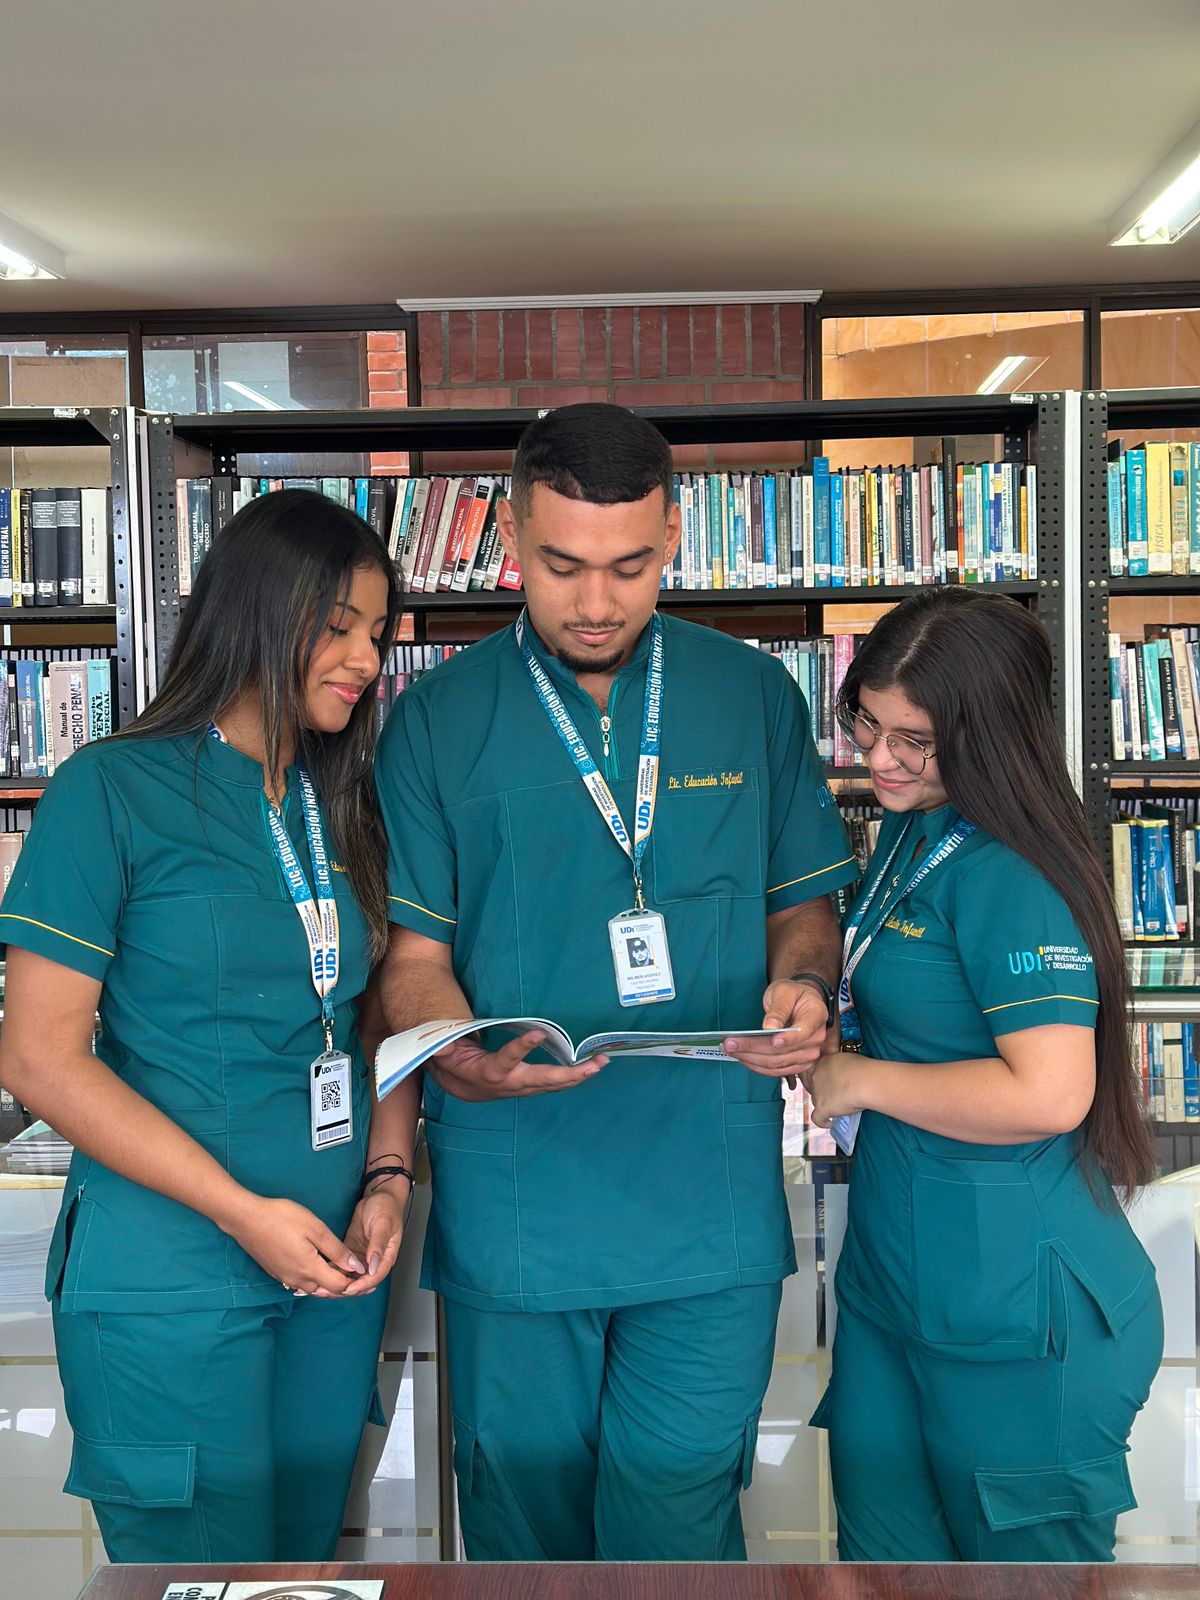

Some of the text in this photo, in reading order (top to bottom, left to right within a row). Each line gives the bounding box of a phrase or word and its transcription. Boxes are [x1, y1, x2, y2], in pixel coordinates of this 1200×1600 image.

[646, 634, 663, 742] LIC. EDUCACIÓN INFANTIL
[60, 702, 66, 710] de
[70, 681, 84, 750] ERECHO PENAL
[528, 656, 589, 762] LIC. EDUCACIÓN INFANTIL
[668, 772, 743, 789] Lic. Educación Infantil
[309, 814, 326, 865] EDUCACIÓN
[928, 833, 964, 869] INFANTIL
[288, 867, 304, 889] LIC.
[318, 868, 329, 885] LIC.
[1043, 945, 1078, 954] UNIVERSIDAD
[1054, 954, 1093, 963] INVESTIGACIÓN
[1052, 962, 1086, 971] DESARROLLO
